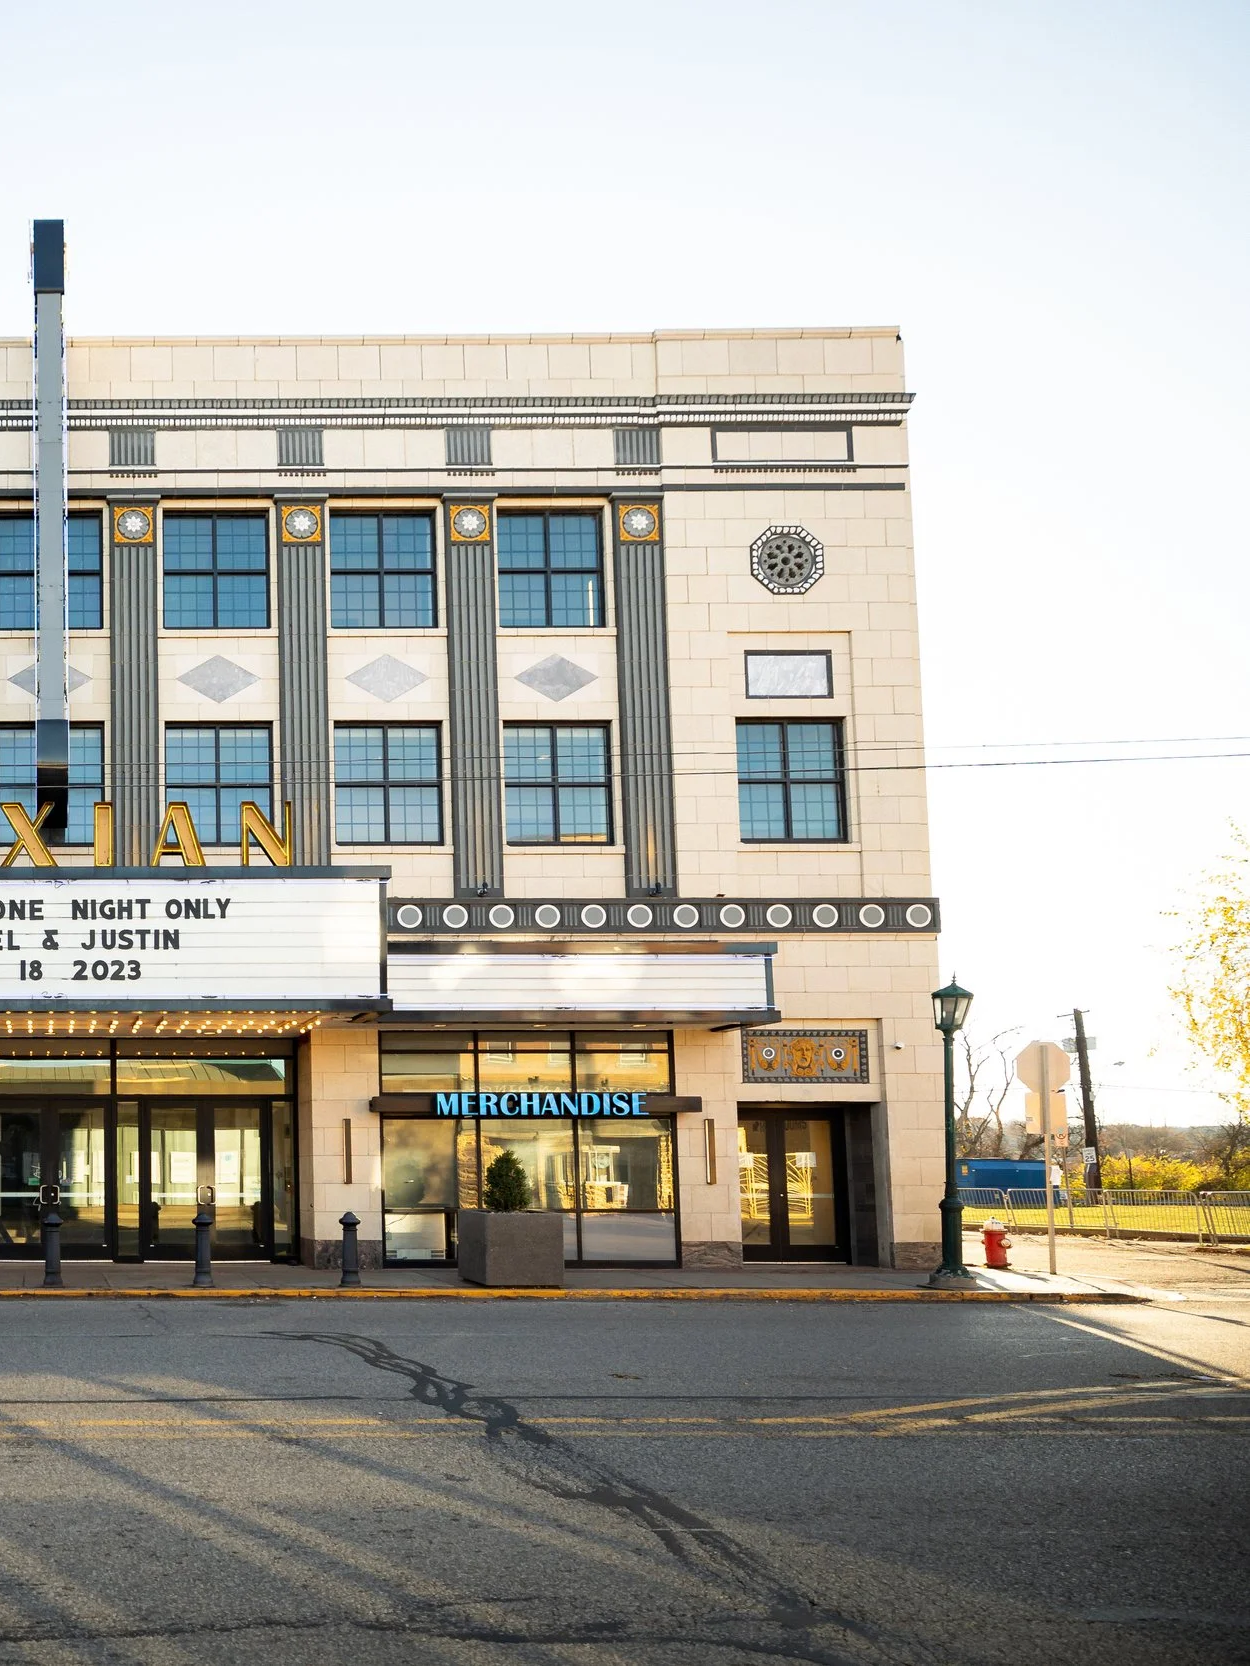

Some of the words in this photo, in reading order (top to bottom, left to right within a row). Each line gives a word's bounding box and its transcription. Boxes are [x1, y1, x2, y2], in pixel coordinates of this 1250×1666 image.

[71, 899, 151, 921] NIGHT
[165, 898, 231, 920] ONLY
[42, 929, 60, 951] &
[81, 929, 180, 951] JUSTIN
[20, 959, 43, 981] 18
[71, 959, 142, 981] 2023
[436, 1092, 648, 1116] MERCHANDISE
[1085, 1155, 1095, 1163] 25
